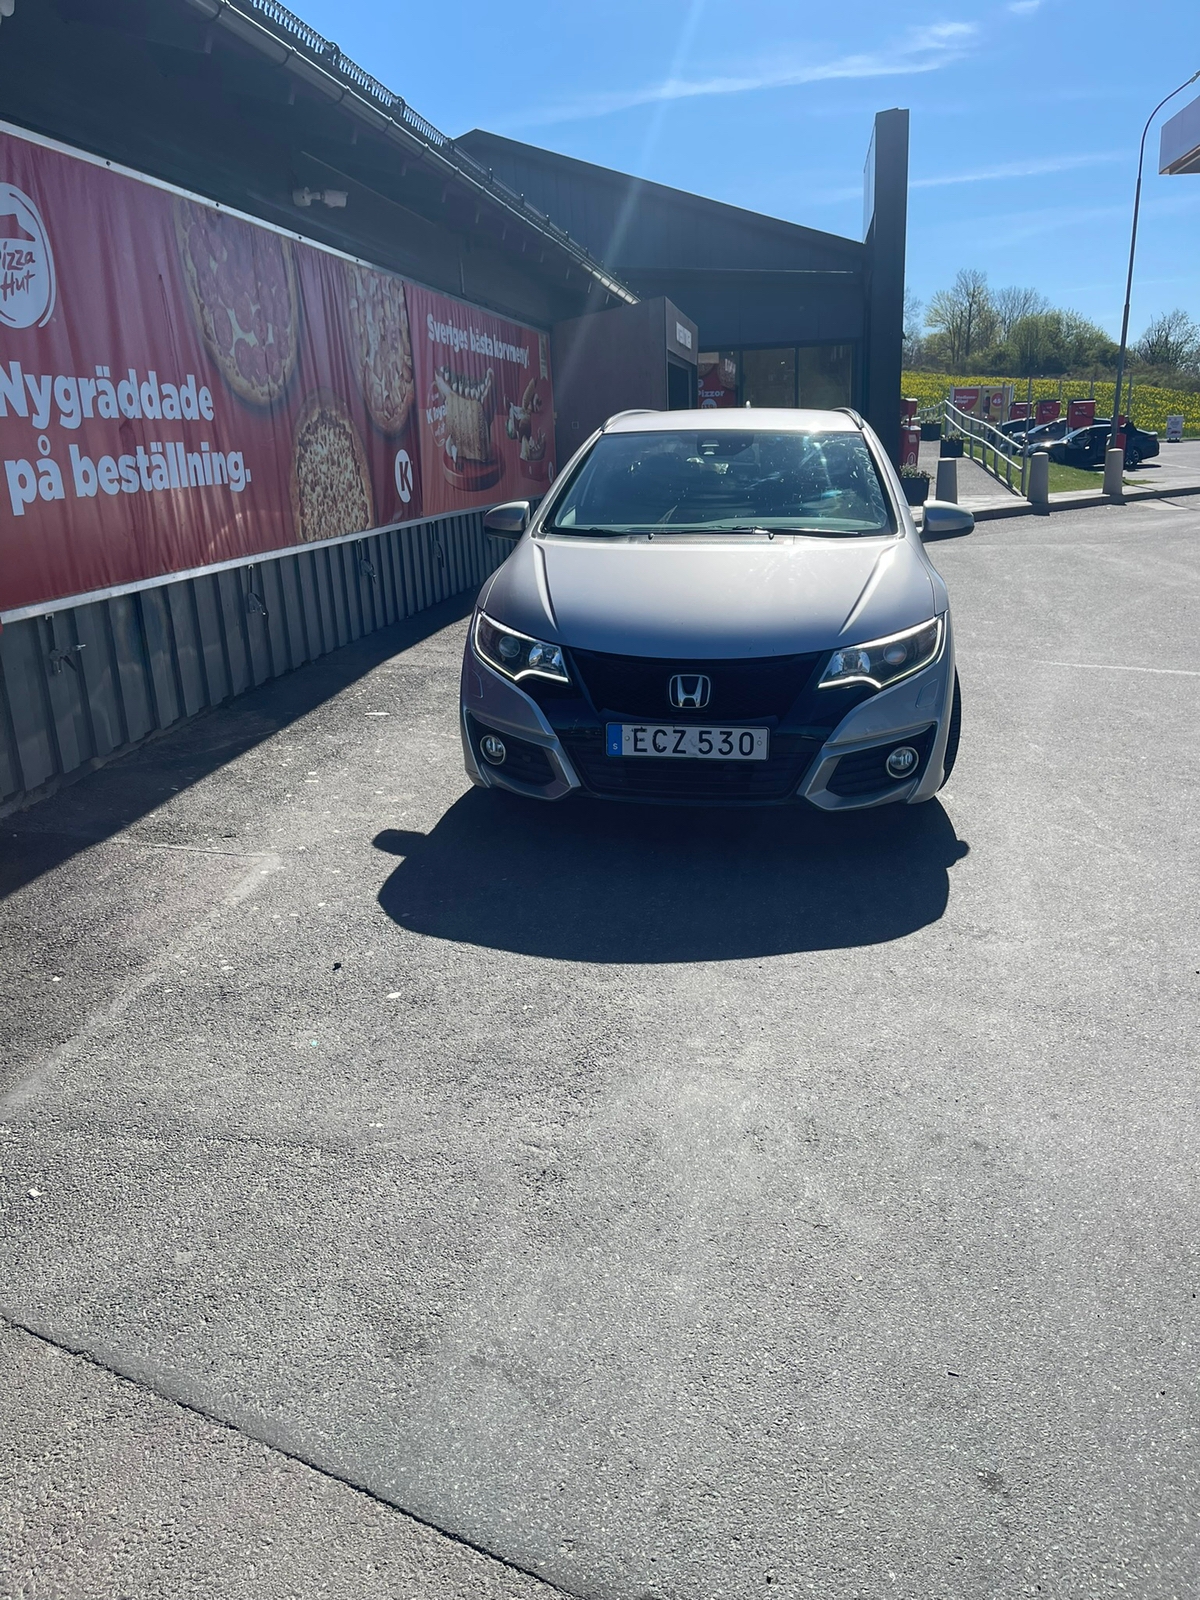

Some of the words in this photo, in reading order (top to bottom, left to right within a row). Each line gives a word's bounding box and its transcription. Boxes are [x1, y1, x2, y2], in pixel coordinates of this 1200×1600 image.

[0, 241, 36, 271] izza
[0, 270, 36, 301] Hut
[427, 313, 468, 353] Sveriges
[469, 326, 494, 357] bästa
[0, 361, 214, 430] Nygräddade
[4, 434, 66, 516] på
[69, 442, 252, 498] beställning.
[633, 727, 687, 754] ECZ
[698, 730, 755, 756] 530
